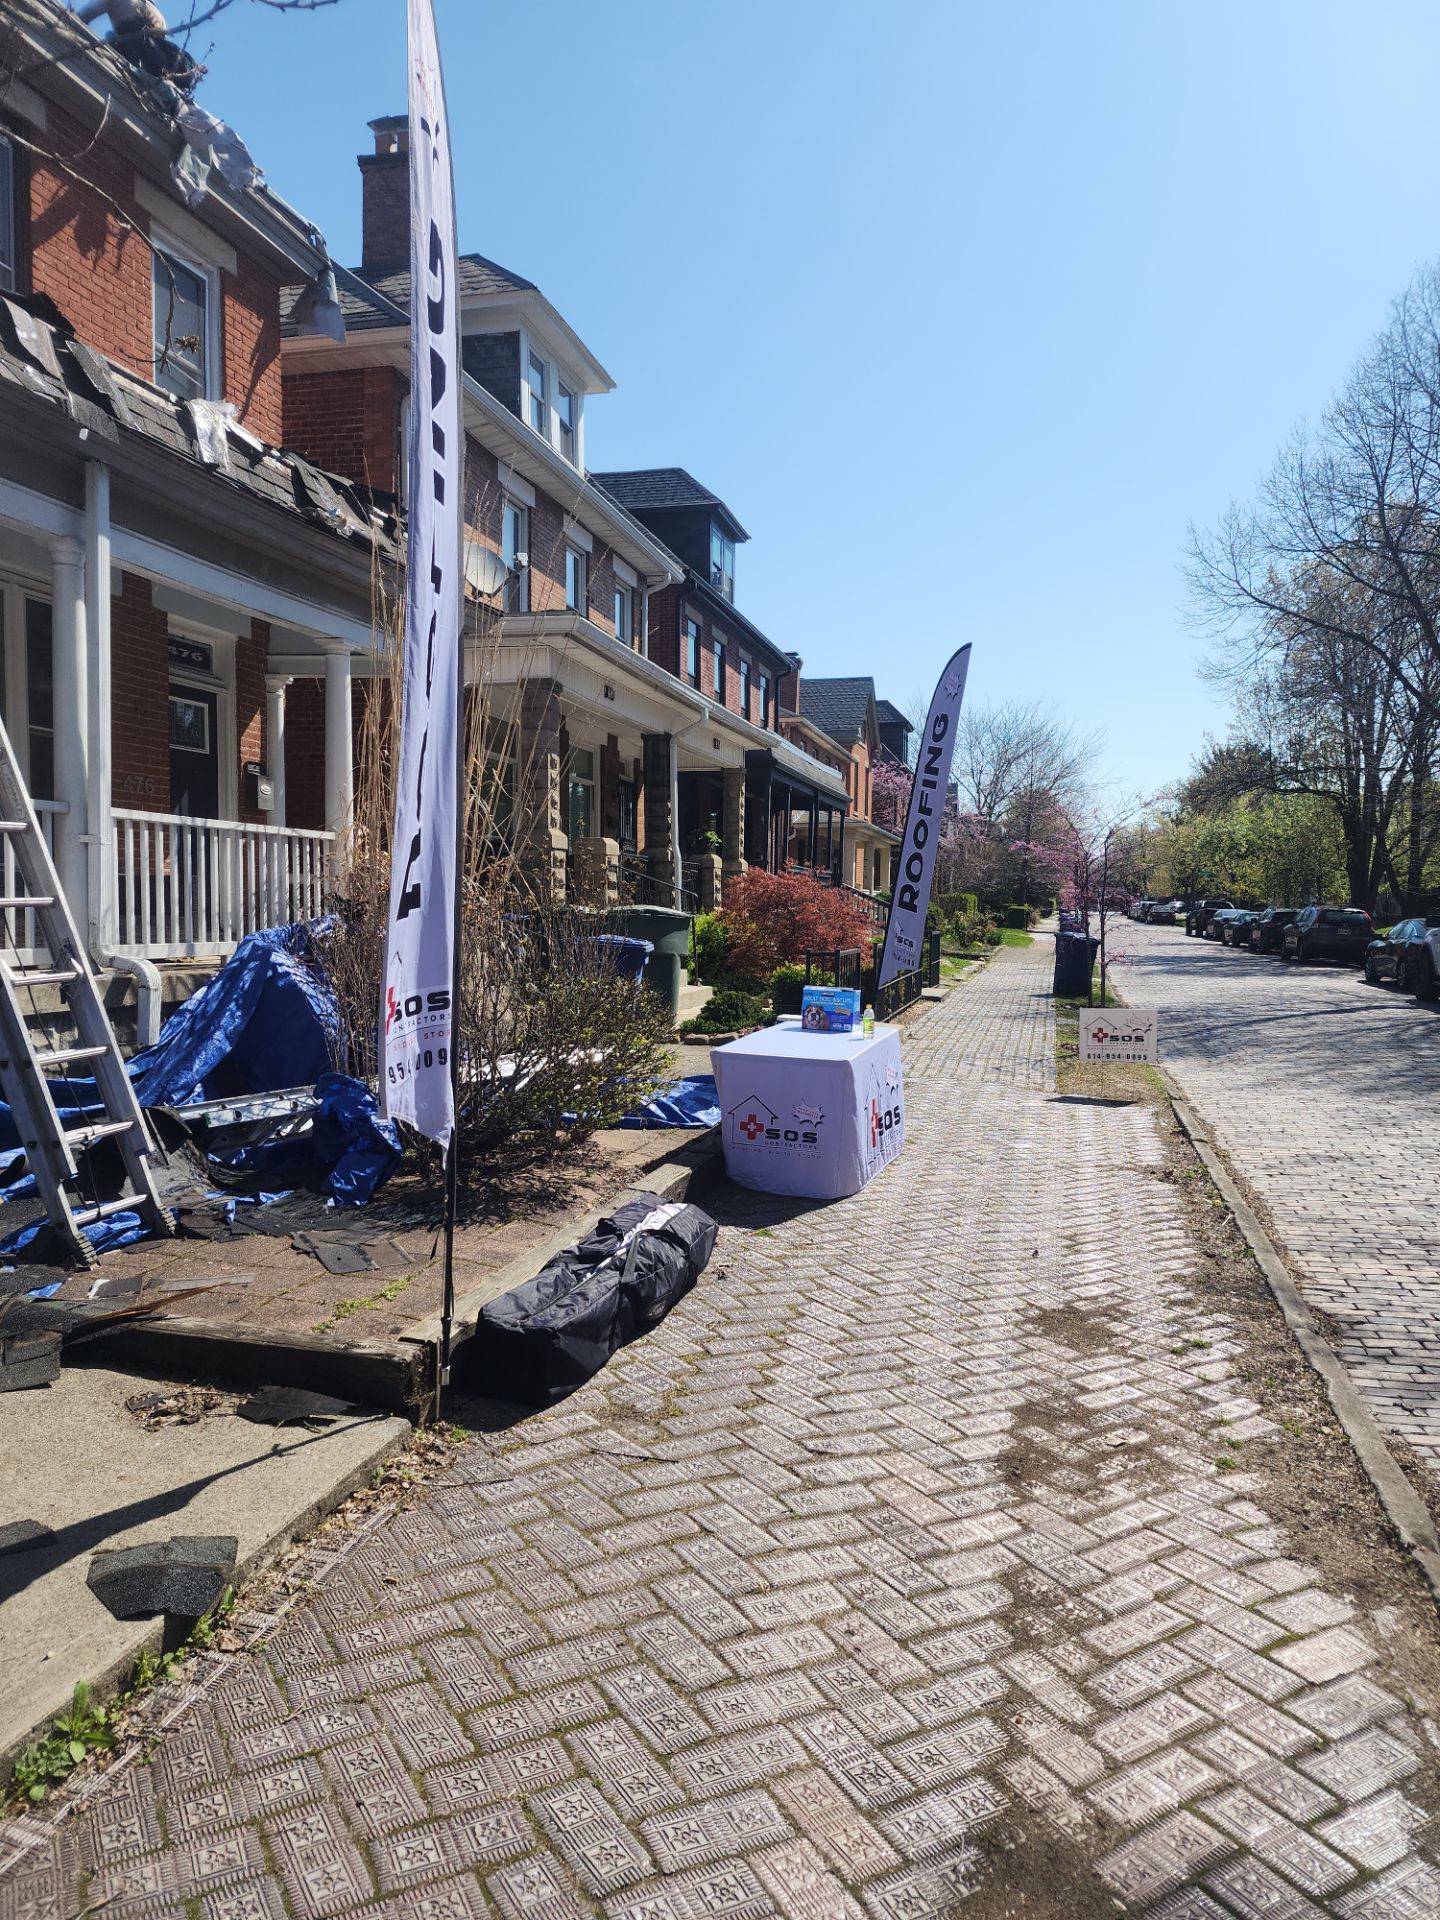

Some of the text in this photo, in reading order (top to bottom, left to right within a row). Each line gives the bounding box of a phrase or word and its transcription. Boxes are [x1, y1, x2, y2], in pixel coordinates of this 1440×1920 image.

[898, 712, 949, 914] ROOFING
[765, 1128, 818, 1144] SOS
[878, 1105, 901, 1136] SOS
